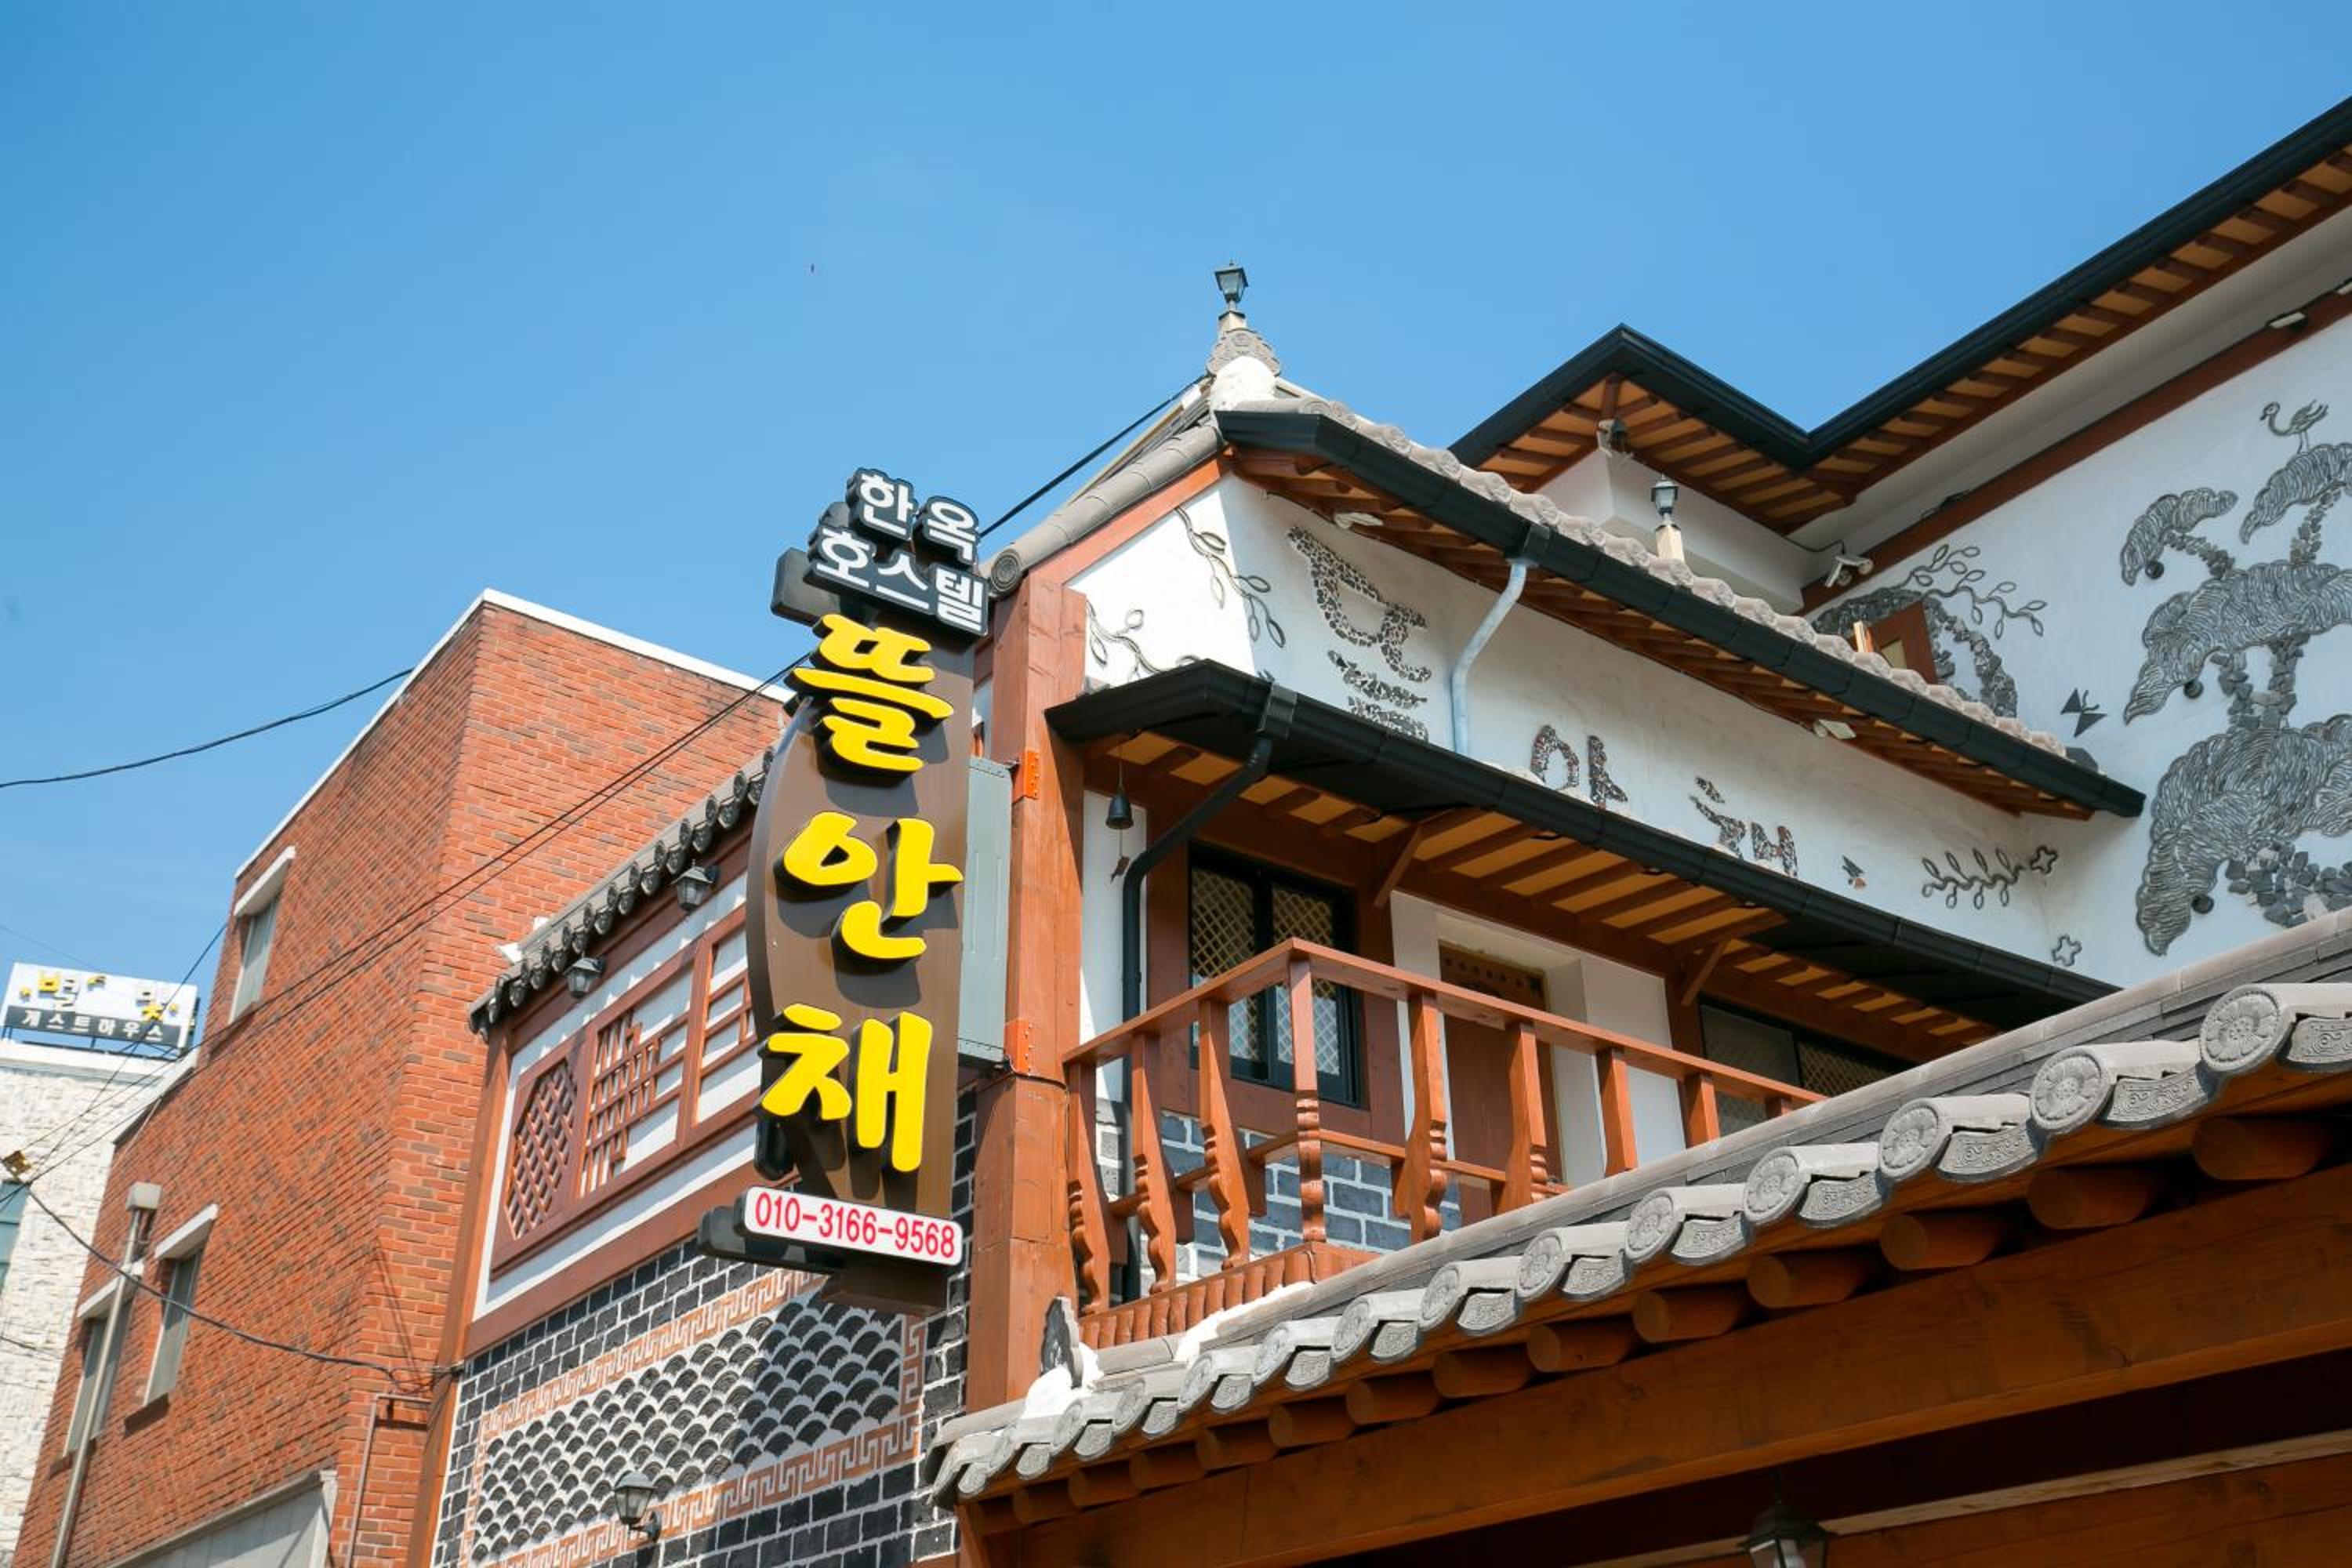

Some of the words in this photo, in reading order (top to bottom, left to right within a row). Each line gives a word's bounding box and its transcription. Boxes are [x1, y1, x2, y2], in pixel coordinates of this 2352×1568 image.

[860, 471, 977, 562] 한옥
[816, 527, 985, 632] 호스텔
[760, 614, 964, 1172] 뜰안채
[21, 1009, 163, 1042] 게스트하우스
[755, 1192, 955, 1258] 010-3166-9568
